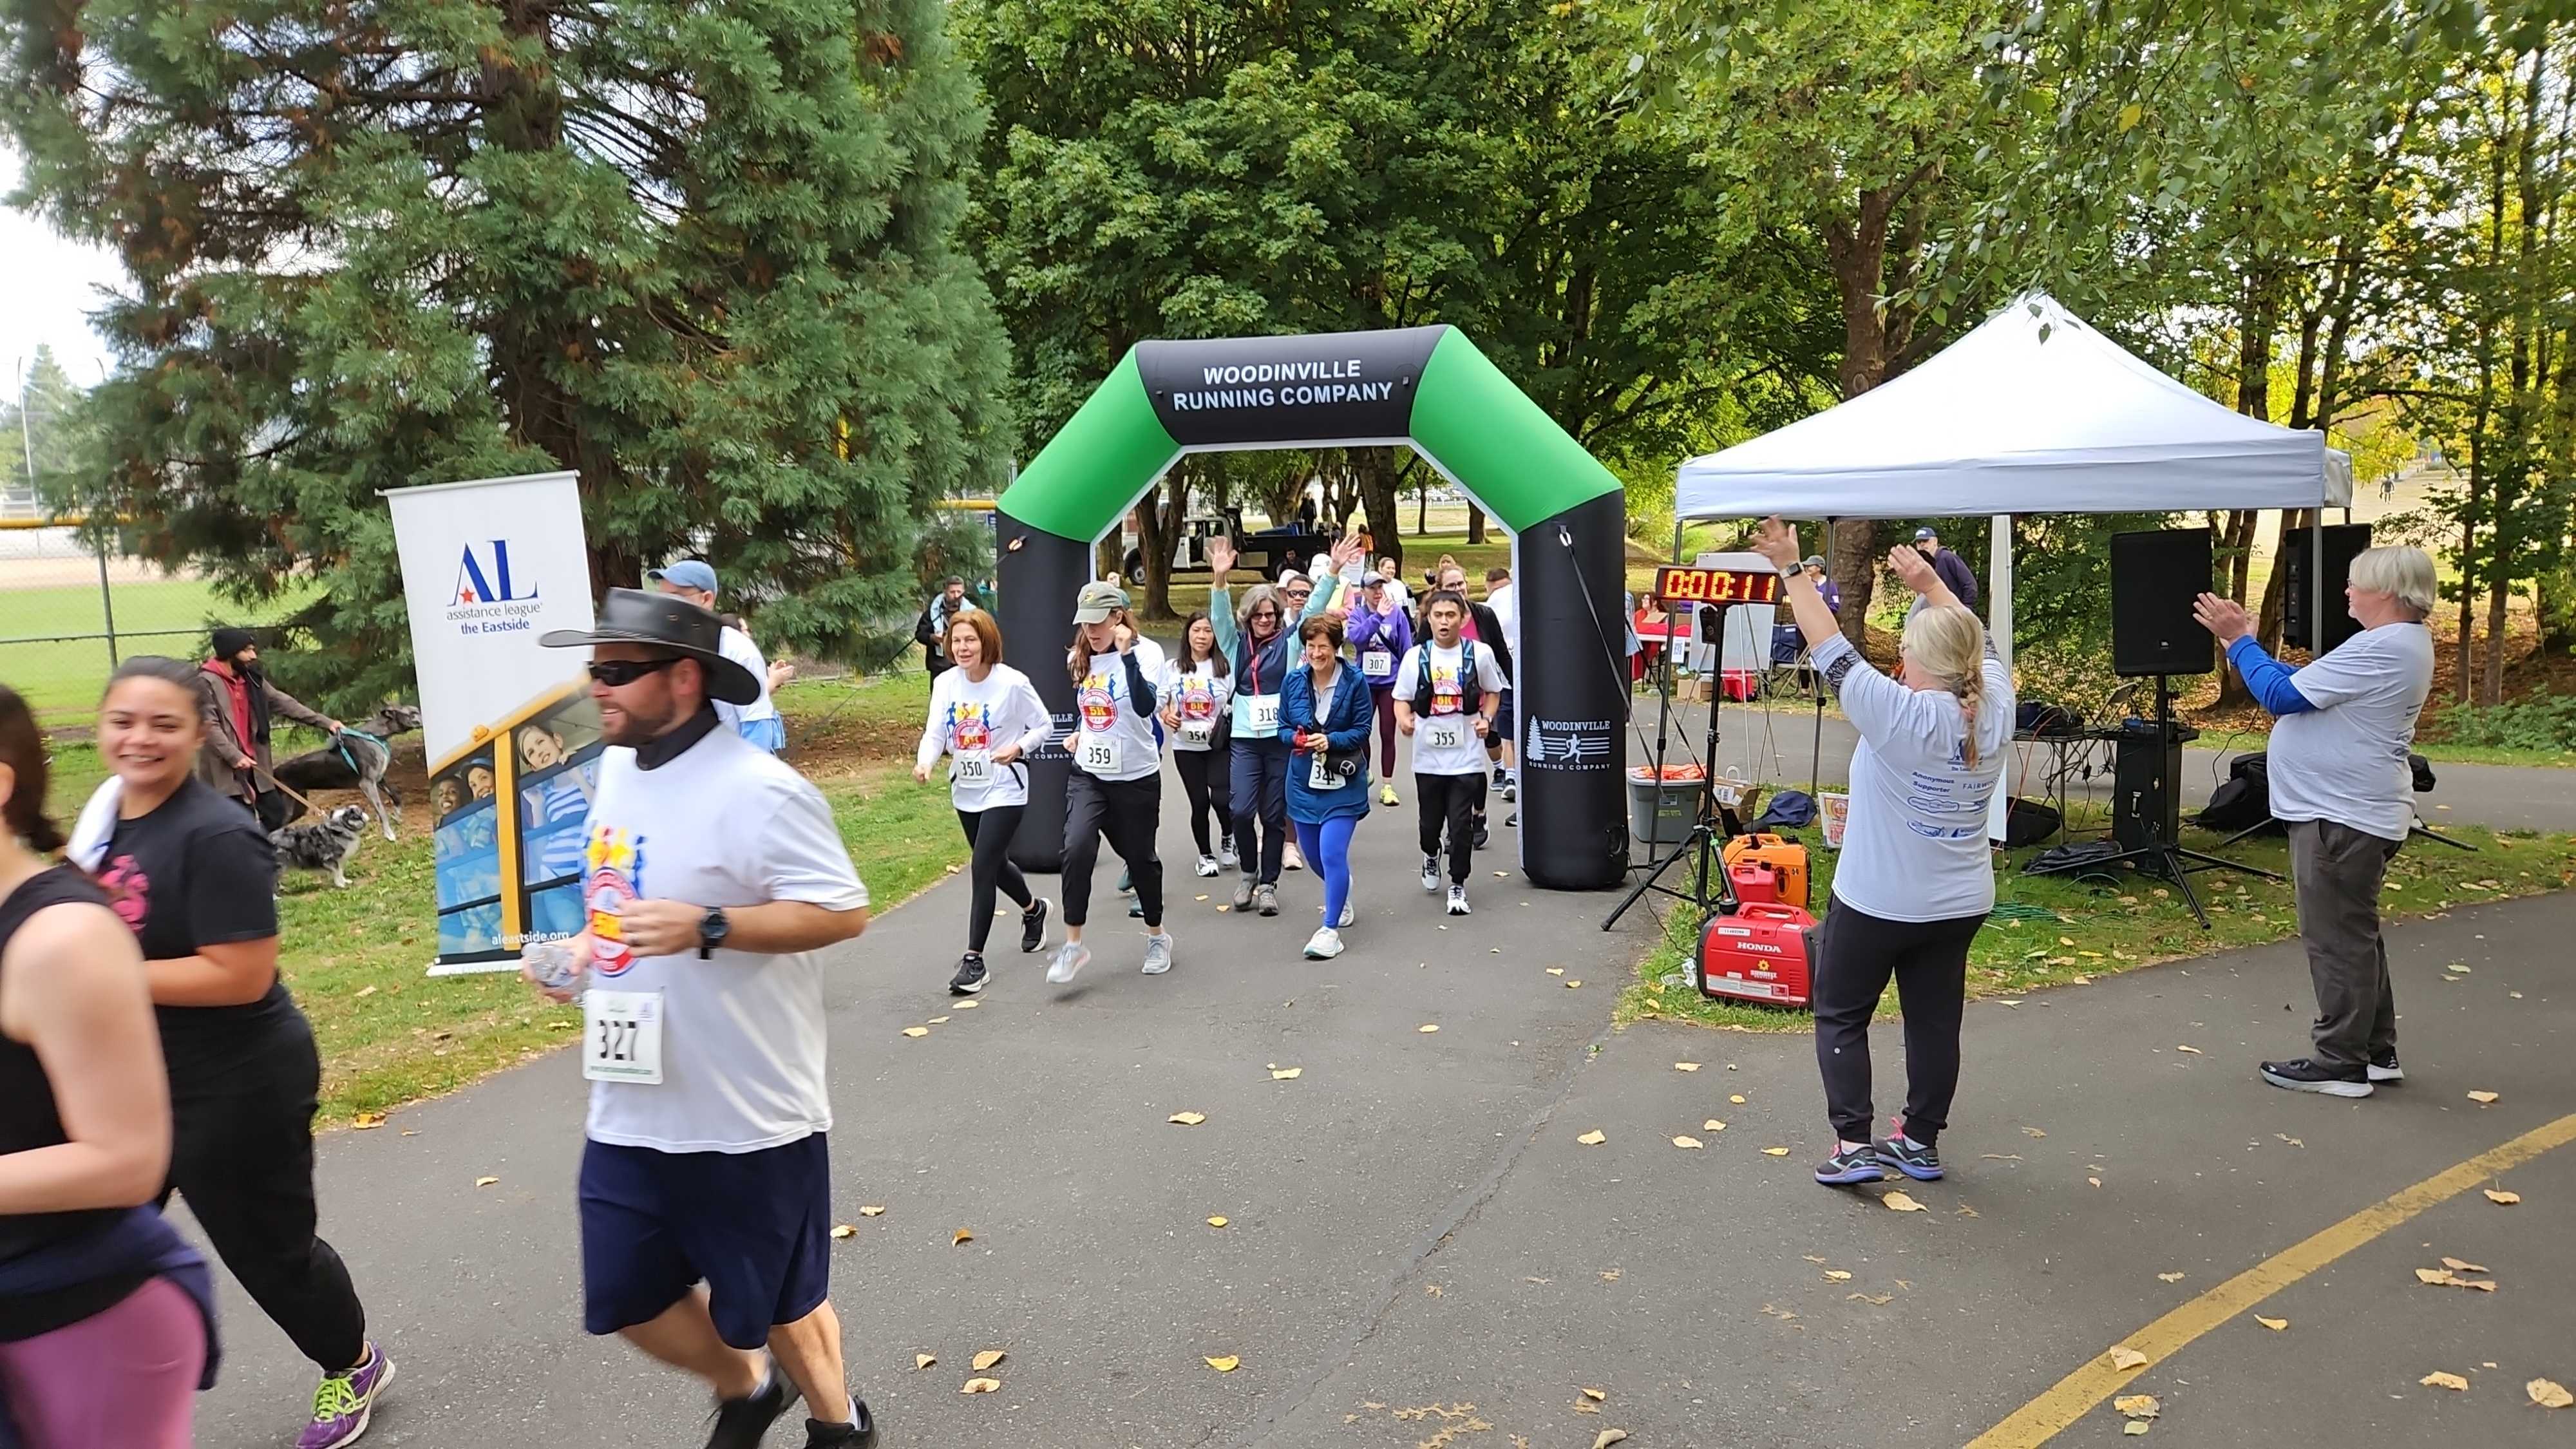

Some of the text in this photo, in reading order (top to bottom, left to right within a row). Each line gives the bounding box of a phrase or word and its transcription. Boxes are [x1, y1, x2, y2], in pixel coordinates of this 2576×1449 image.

[1203, 359, 1362, 385] WOODINVILLE
[1173, 381, 1393, 411] RUNNING COMPANY
[447, 539, 538, 607] AL
[1665, 569, 1776, 601] 0:00:11
[446, 602, 540, 621] assistance league
[461, 618, 530, 634] the Eastside
[1369, 659, 1384, 670] 307
[1089, 706, 1107, 715] 5K
[1258, 707, 1278, 721] 318
[1541, 721, 1610, 730] WOODINVILLE
[1188, 731, 1207, 741] 354
[1434, 732, 1455, 745] 355
[1088, 747, 1111, 764] 359
[960, 761, 982, 776] 350
[1529, 761, 1564, 770] RUNNING
[1912, 772, 1955, 784] Anonymous
[1913, 781, 1951, 793] Supporter
[1737, 942, 1783, 953] HONDA
[598, 1019, 637, 1061] 327
